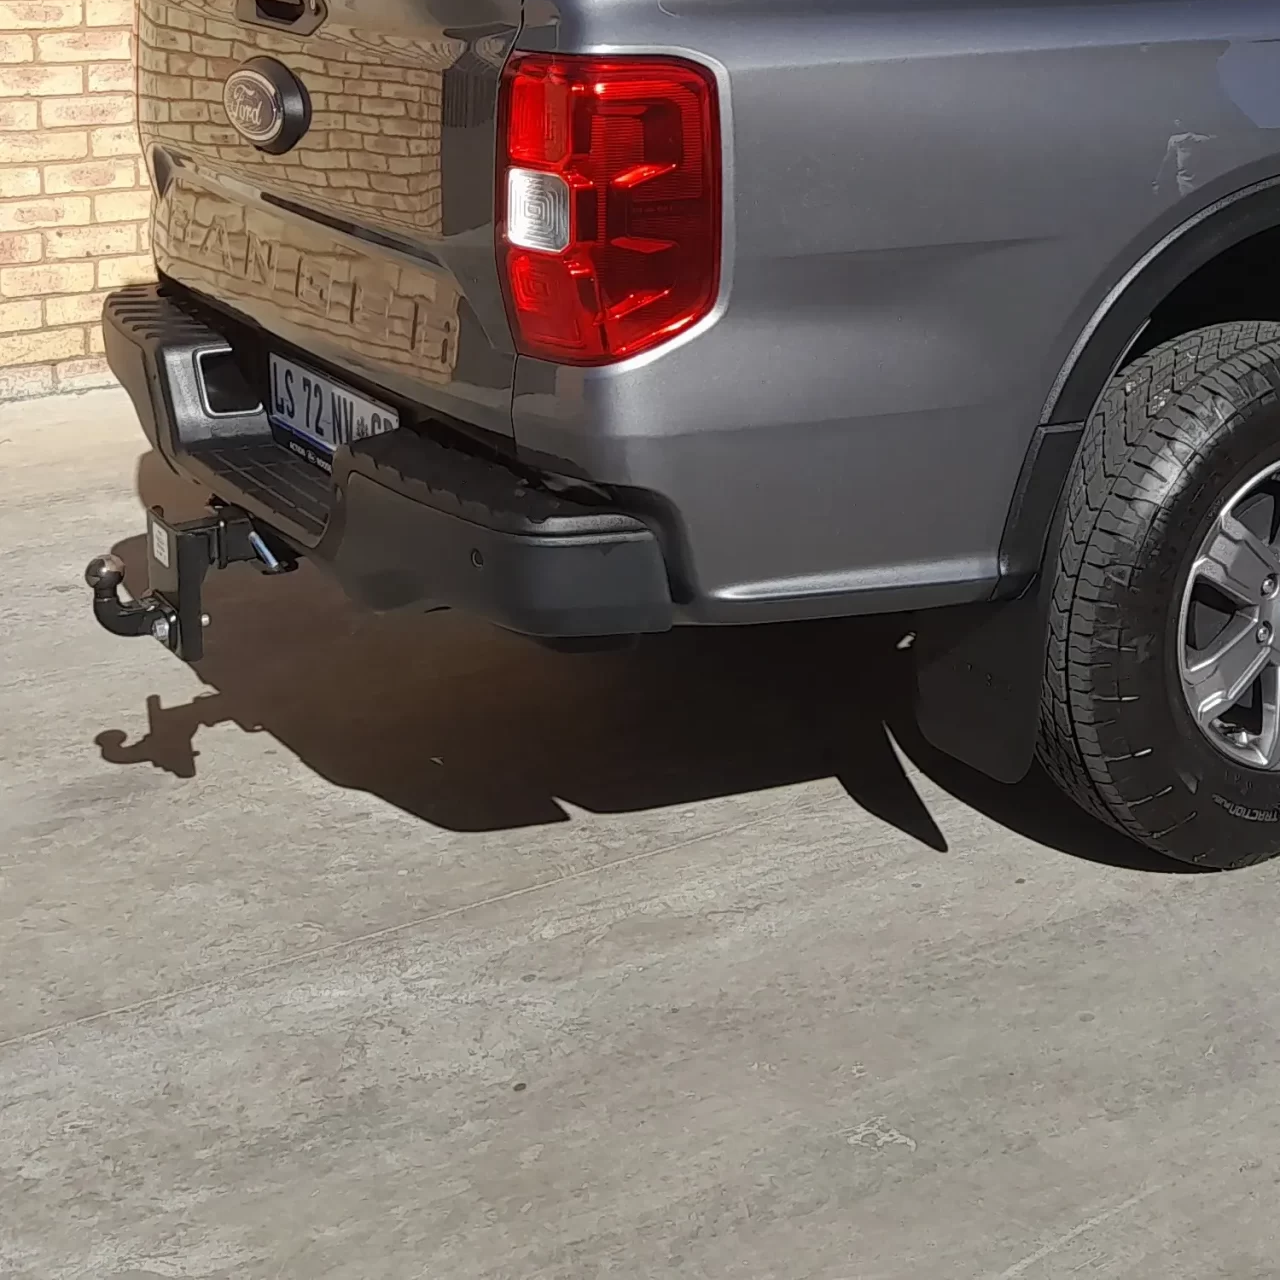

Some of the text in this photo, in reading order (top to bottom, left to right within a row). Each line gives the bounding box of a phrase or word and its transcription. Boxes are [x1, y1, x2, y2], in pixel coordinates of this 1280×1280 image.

[228, 83, 264, 126] Ford
[273, 361, 296, 419] LS
[302, 376, 325, 437] 72
[331, 391, 354, 445] NV
